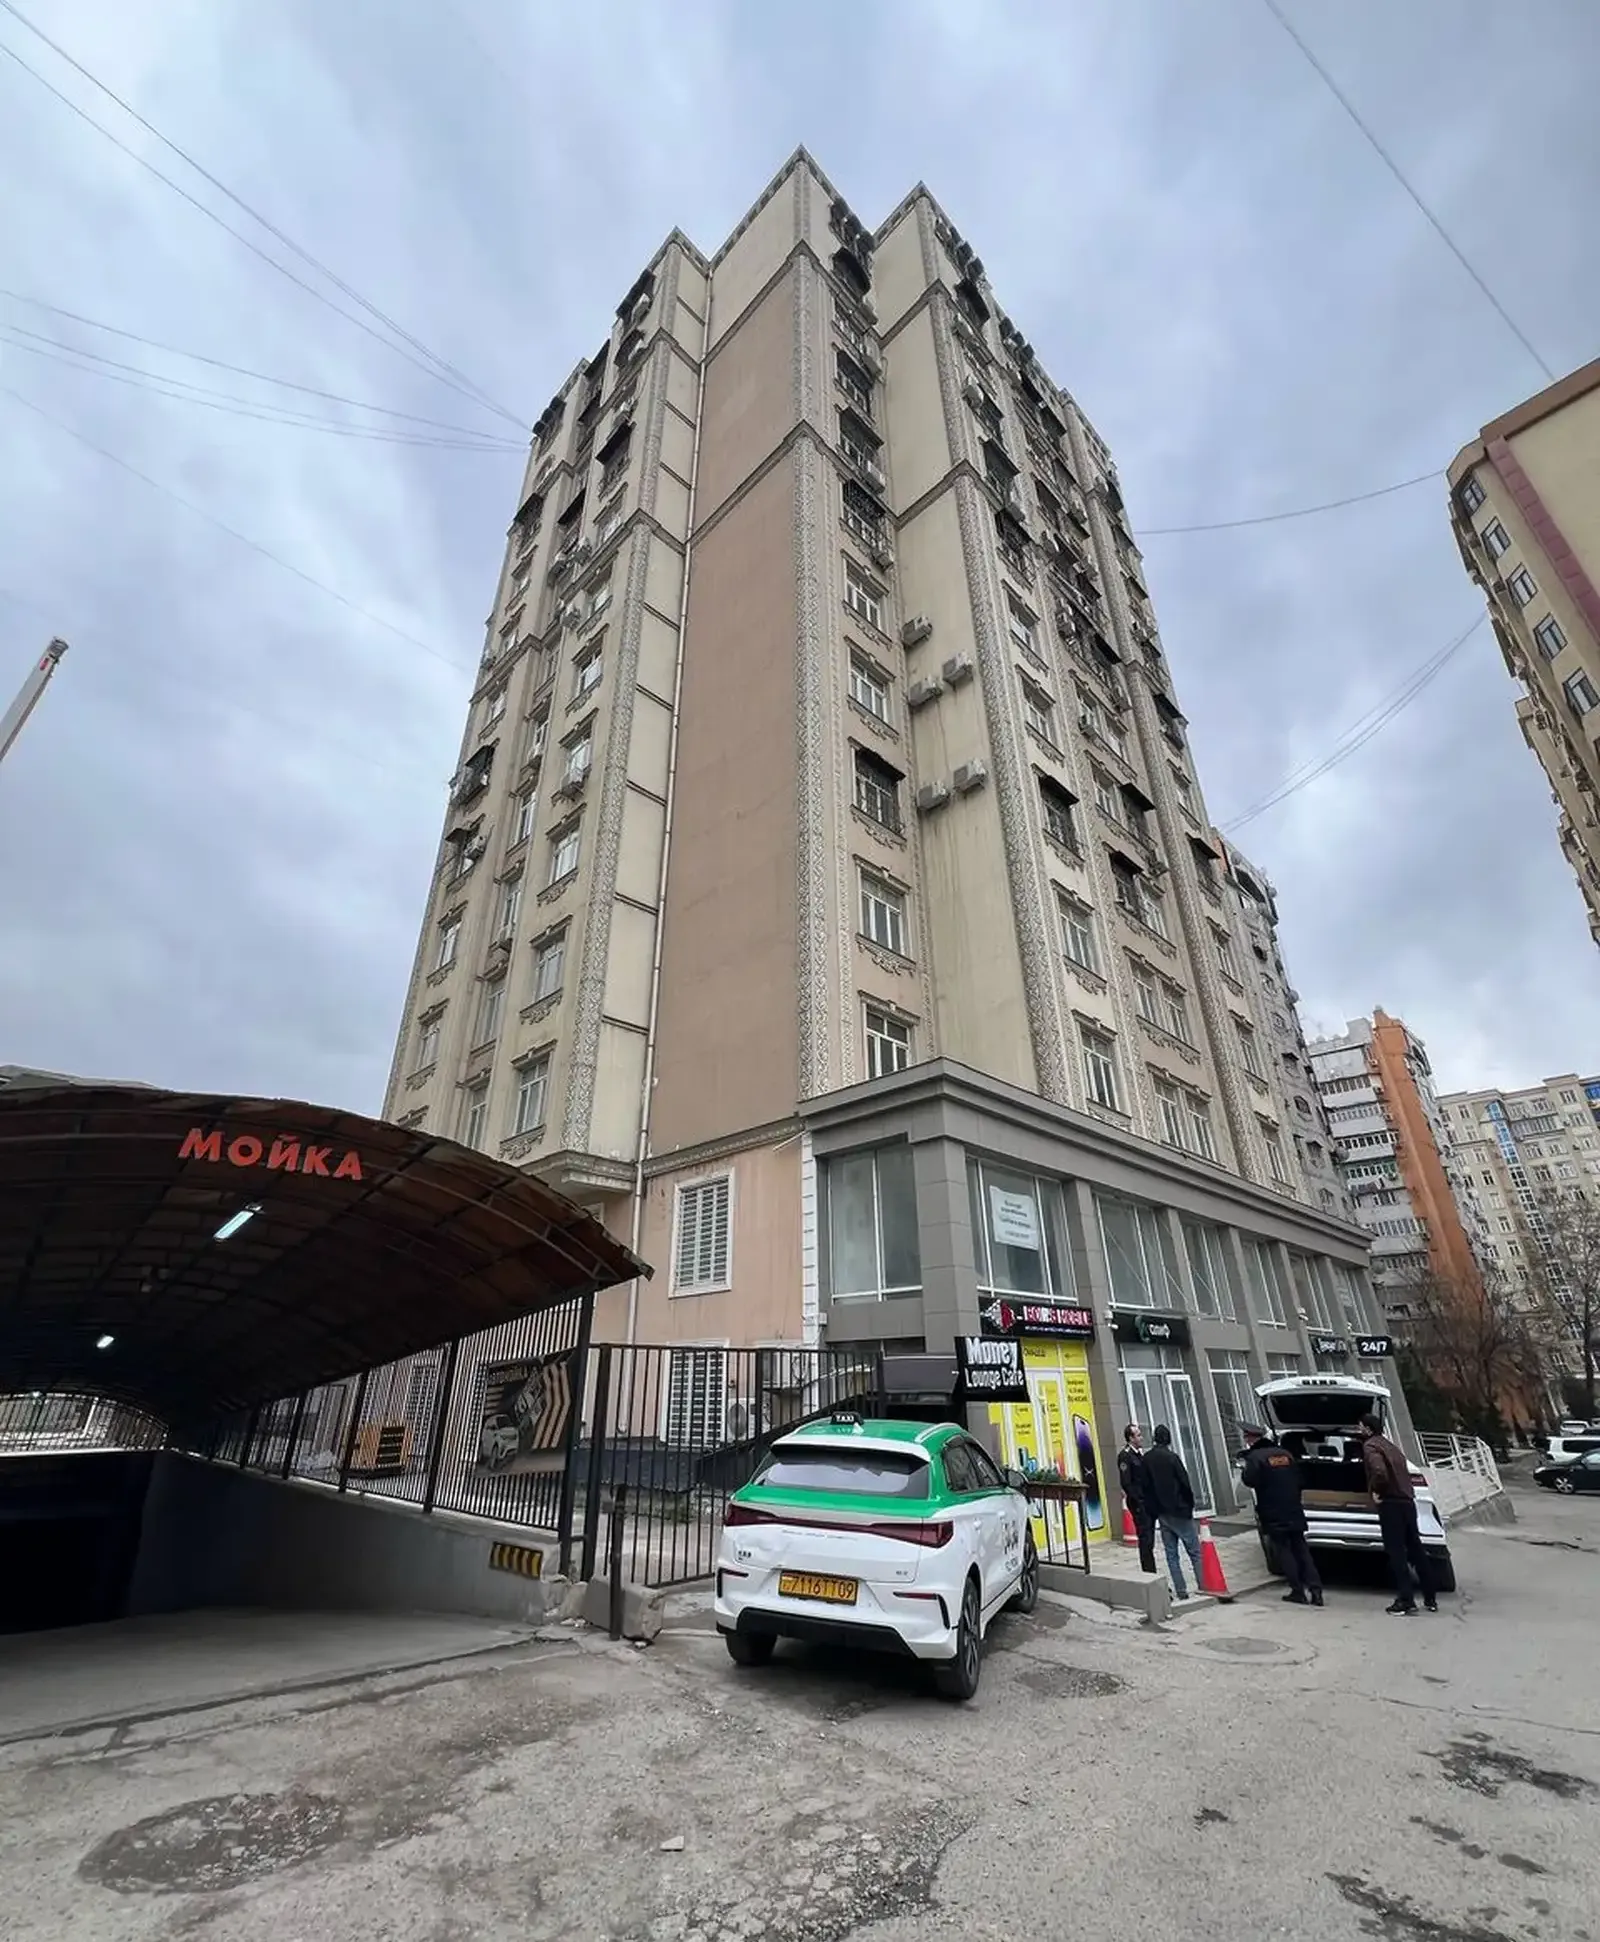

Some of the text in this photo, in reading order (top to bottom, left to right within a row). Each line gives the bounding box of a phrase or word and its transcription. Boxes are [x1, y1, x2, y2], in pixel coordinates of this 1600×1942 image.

[178, 1127, 363, 1181] МОЙКА
[965, 1337, 1018, 1371] Money
[1361, 1340, 1387, 1354] 24/7
[964, 1367, 1001, 1390] Lounge
